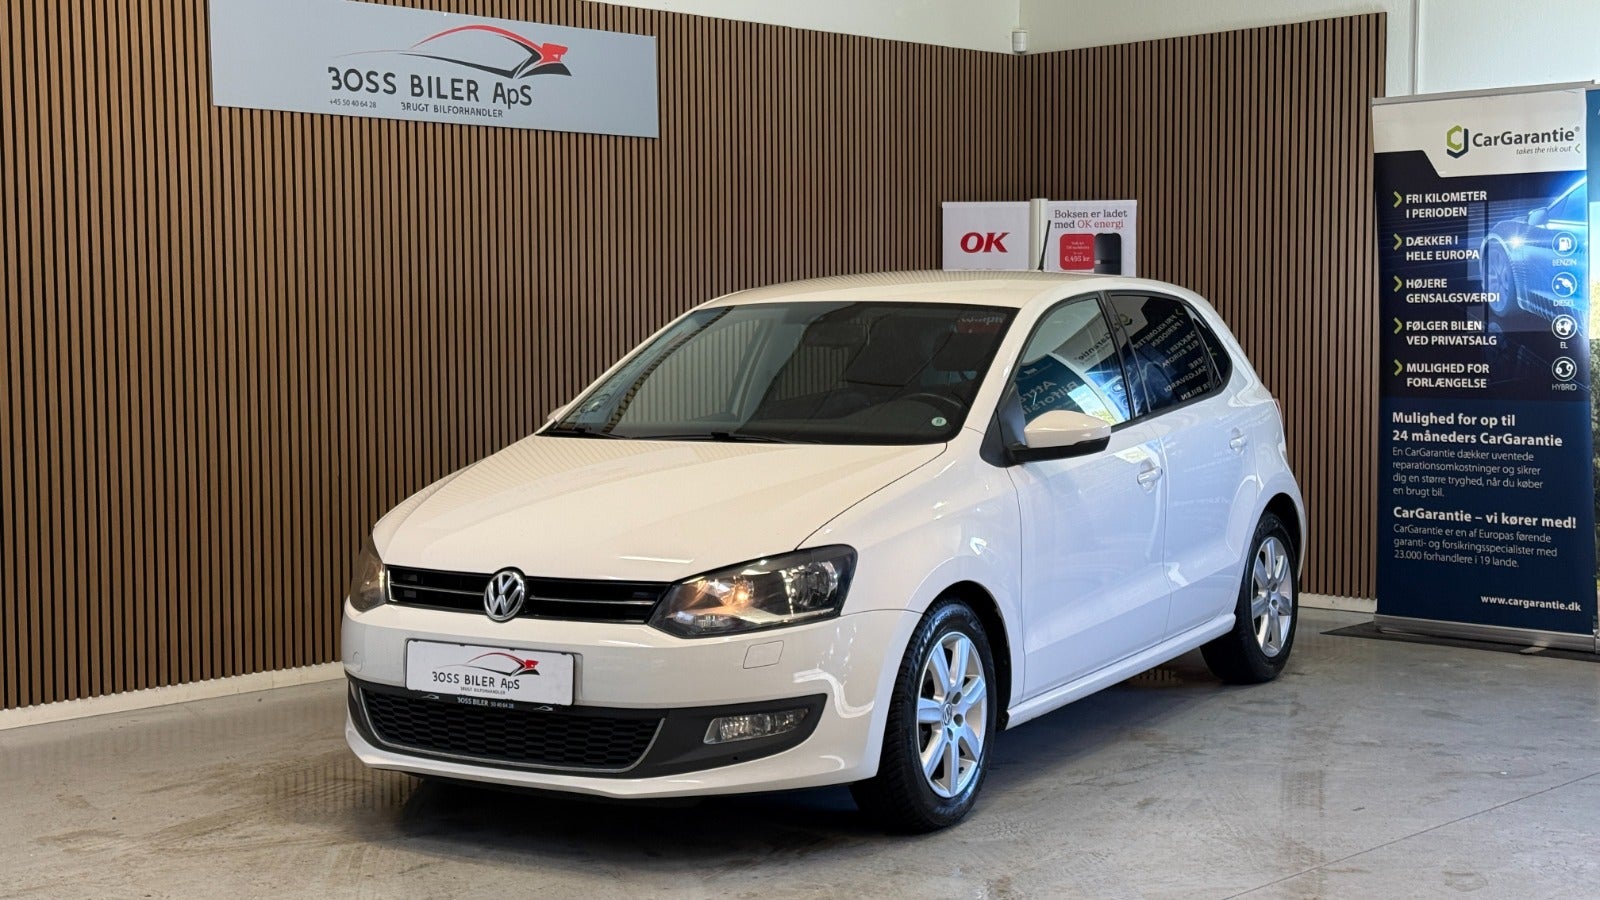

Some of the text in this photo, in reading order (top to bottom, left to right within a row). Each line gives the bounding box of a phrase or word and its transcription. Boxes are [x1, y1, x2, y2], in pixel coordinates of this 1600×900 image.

[410, 74, 479, 104] BILER
[492, 81, 533, 110] ApS
[433, 104, 504, 118] BILFORHANDLER
[1516, 147, 1532, 156] takes
[1406, 191, 1488, 204] FRI KILOMETER
[1054, 209, 1089, 218] Boksen
[1103, 209, 1128, 218] ladet
[1406, 207, 1468, 218] I PERIODEN
[1054, 220, 1124, 230] med OK energi
[960, 232, 1010, 254] OK
[1406, 236, 1458, 246] DÆKKER I
[1406, 250, 1480, 260] HELE EUROPA
[1552, 258, 1577, 266] BENZIN
[1406, 278, 1448, 289] HØJERE
[1406, 292, 1500, 304] GENSALGSVÆRDI
[1406, 320, 1482, 332] FØLGER BILEN
[1406, 335, 1498, 346] VED PRIVATSALG
[1560, 342, 1568, 350] EL
[1406, 363, 1490, 374] MULIGHED FOR
[1406, 378, 1487, 388] FORLÆNGELSE
[1552, 384, 1577, 392] HYBRID
[1392, 412, 1516, 428] Mulighed for op til
[1392, 430, 1563, 447] 24 måneders CarGarantie
[1392, 447, 1534, 462] En CarGarantie dækker uventede
[1392, 460, 1542, 476] reparationsomkostninger og sikrer
[1392, 473, 1406, 484] dig
[1422, 476, 1446, 484] større
[1448, 476, 1484, 488] tryghed,
[1486, 478, 1501, 487] når
[1502, 478, 1515, 488] du
[1516, 480, 1544, 489] køber
[1406, 488, 1430, 498] brugt
[1432, 488, 1444, 497] bil.
[1393, 507, 1472, 522] CarGarantie
[1486, 512, 1498, 524] vi
[1501, 513, 1537, 527] kører
[1542, 517, 1577, 529] med!
[1393, 524, 1552, 543] CarGarantie er en af Europas førende
[1394, 538, 1558, 557] garanti- og forsikringsspecialister med
[1394, 550, 1422, 560] 23.000
[1424, 552, 1472, 564] forhandlere
[1480, 556, 1490, 565] 19
[1492, 557, 1519, 568] lande.
[1480, 594, 1582, 612] www.cargarantie.dk
[464, 674, 495, 688] BILER
[500, 678, 520, 692] ApS
[472, 698, 489, 707] BILER
